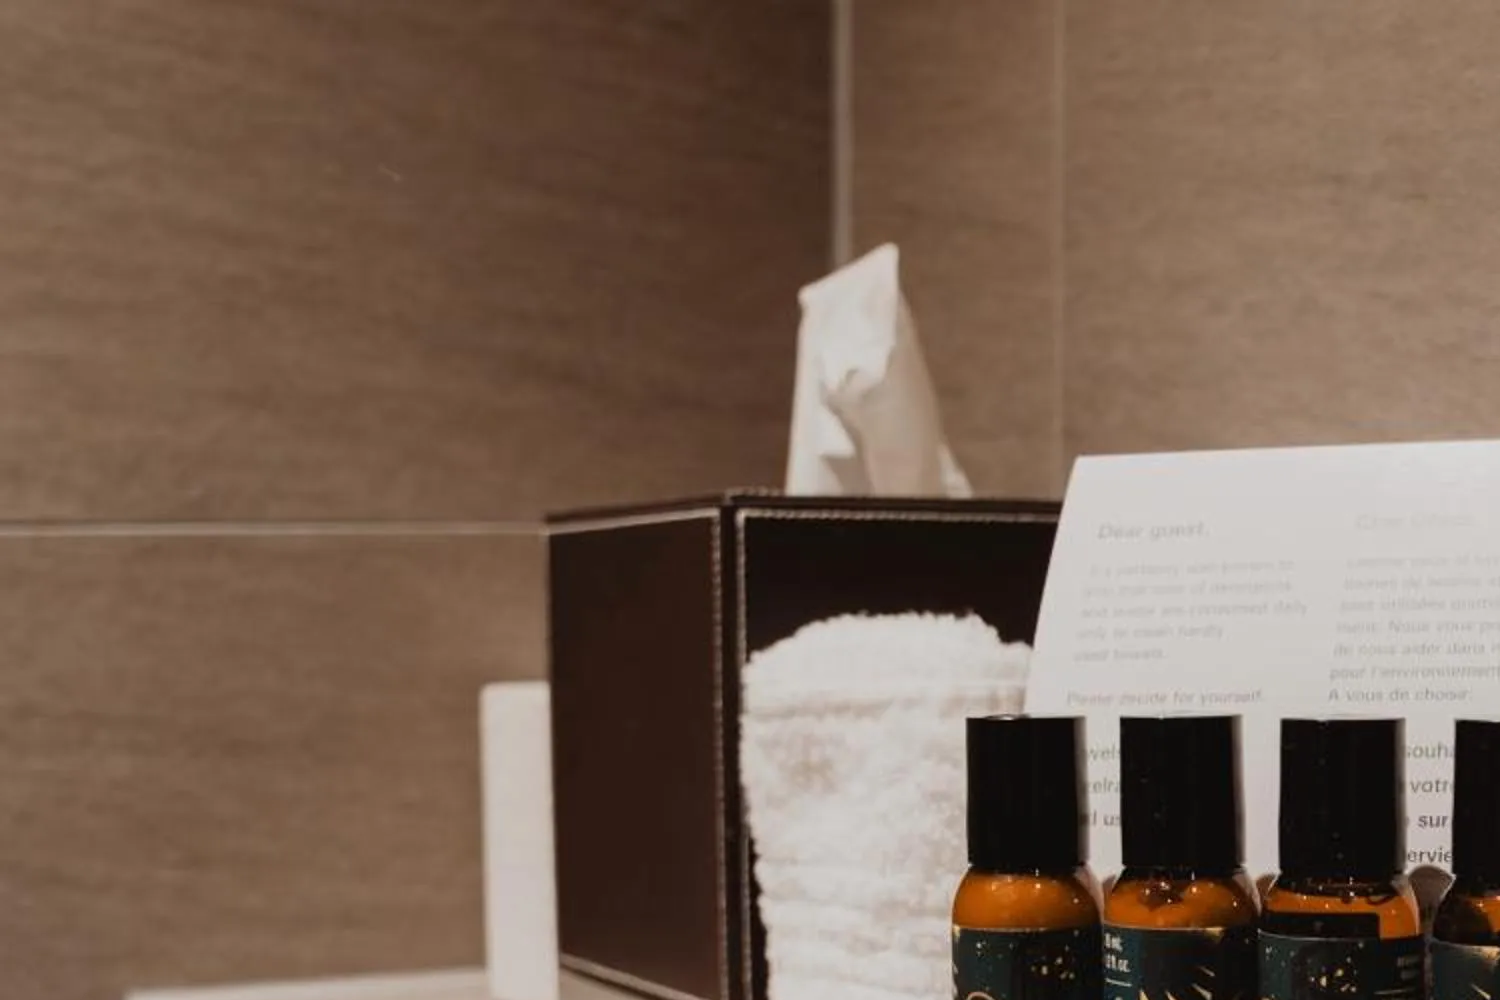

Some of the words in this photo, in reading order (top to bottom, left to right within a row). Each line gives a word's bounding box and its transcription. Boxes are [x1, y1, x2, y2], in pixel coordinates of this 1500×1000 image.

[1096, 523, 1144, 541] Dear
[1173, 689, 1196, 703] for
[1346, 689, 1384, 702] vous
[1389, 688, 1411, 702] de
[1418, 814, 1449, 829] sur
